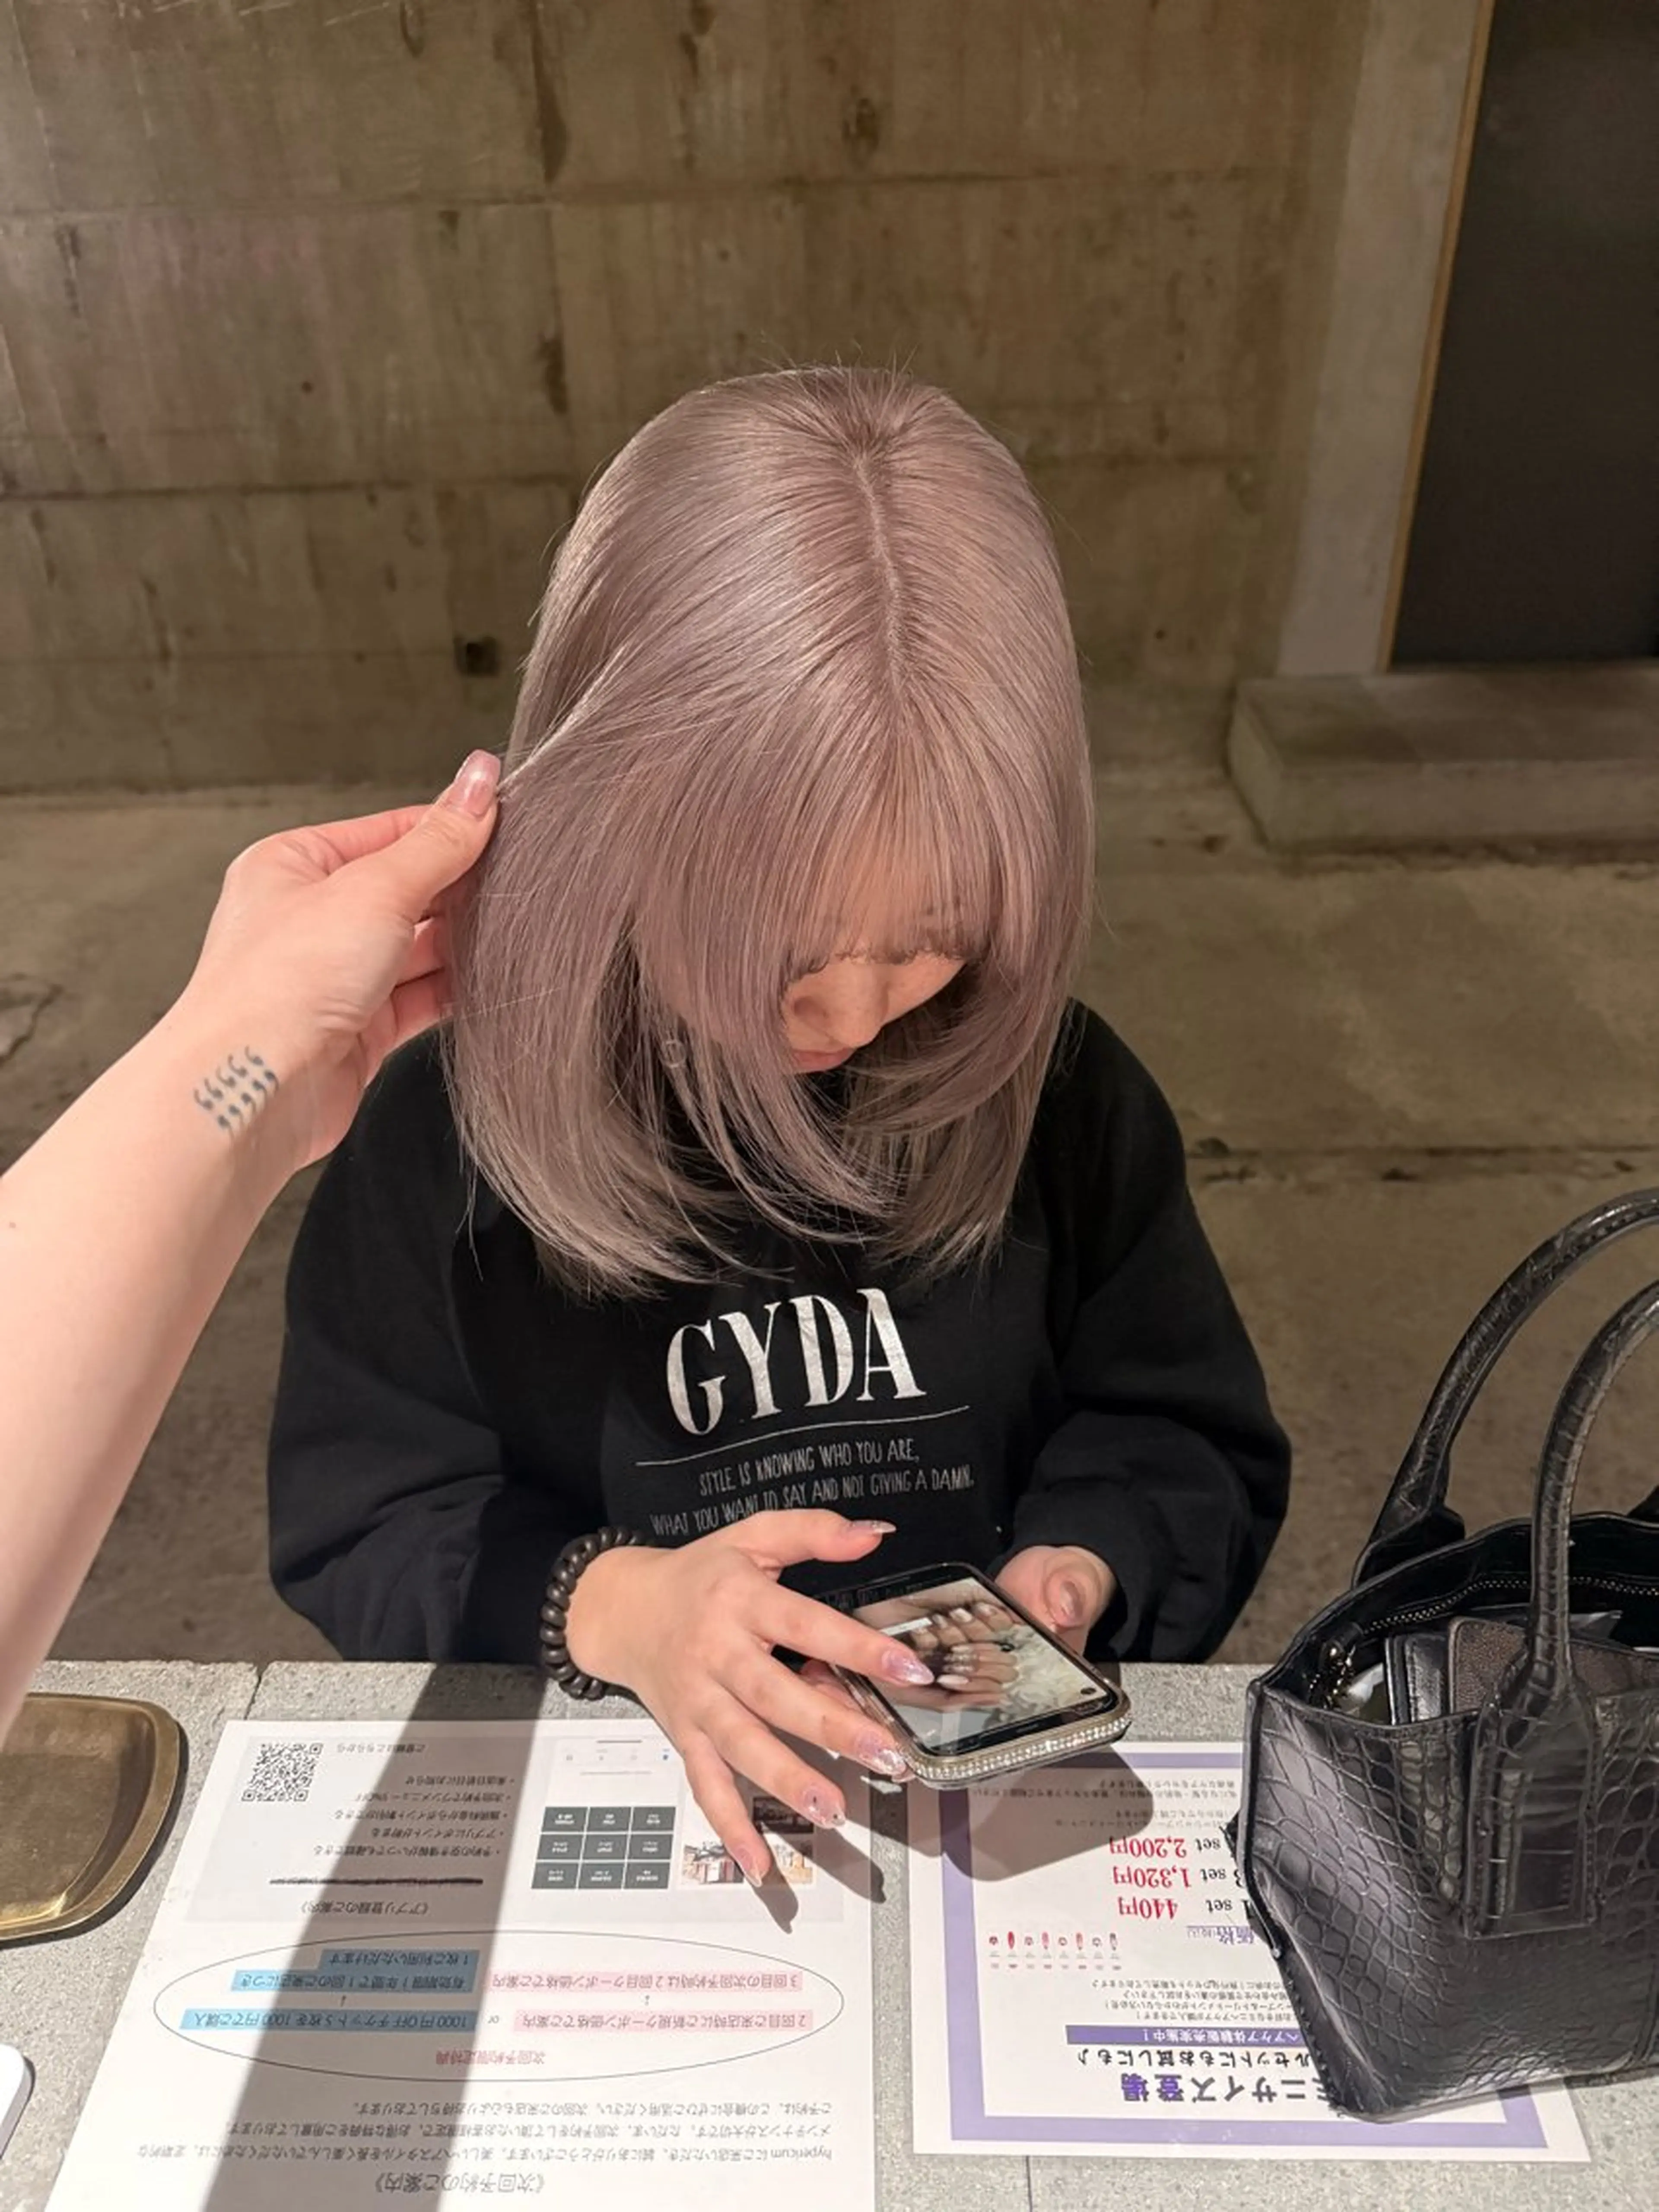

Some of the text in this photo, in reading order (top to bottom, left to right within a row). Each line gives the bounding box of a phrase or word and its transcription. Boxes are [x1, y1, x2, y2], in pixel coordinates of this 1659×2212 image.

[666, 1288, 927, 1436] GYDA
[699, 1438, 920, 1496] STYLE IS KNOWING WHO YOU ARE,
[649, 1513, 689, 1536] WHAT
[693, 1506, 719, 1532] YOU
[721, 1493, 758, 1523] WANT
[763, 1490, 778, 1511] TO
[782, 1481, 806, 1508] SAY
[811, 1476, 839, 1503] AND
[842, 1474, 864, 1499] NOT
[871, 1470, 912, 1496] GIVING
[915, 1468, 928, 1491] A
[1109, 1836, 1220, 1859] set 2,200円
[1112, 1866, 1191, 1889] 1,320円
[1200, 1868, 1226, 1883] set
[1118, 1896, 1178, 1920] 440円
[1205, 1899, 1232, 1913] set
[487, 2016, 499, 2024] or
